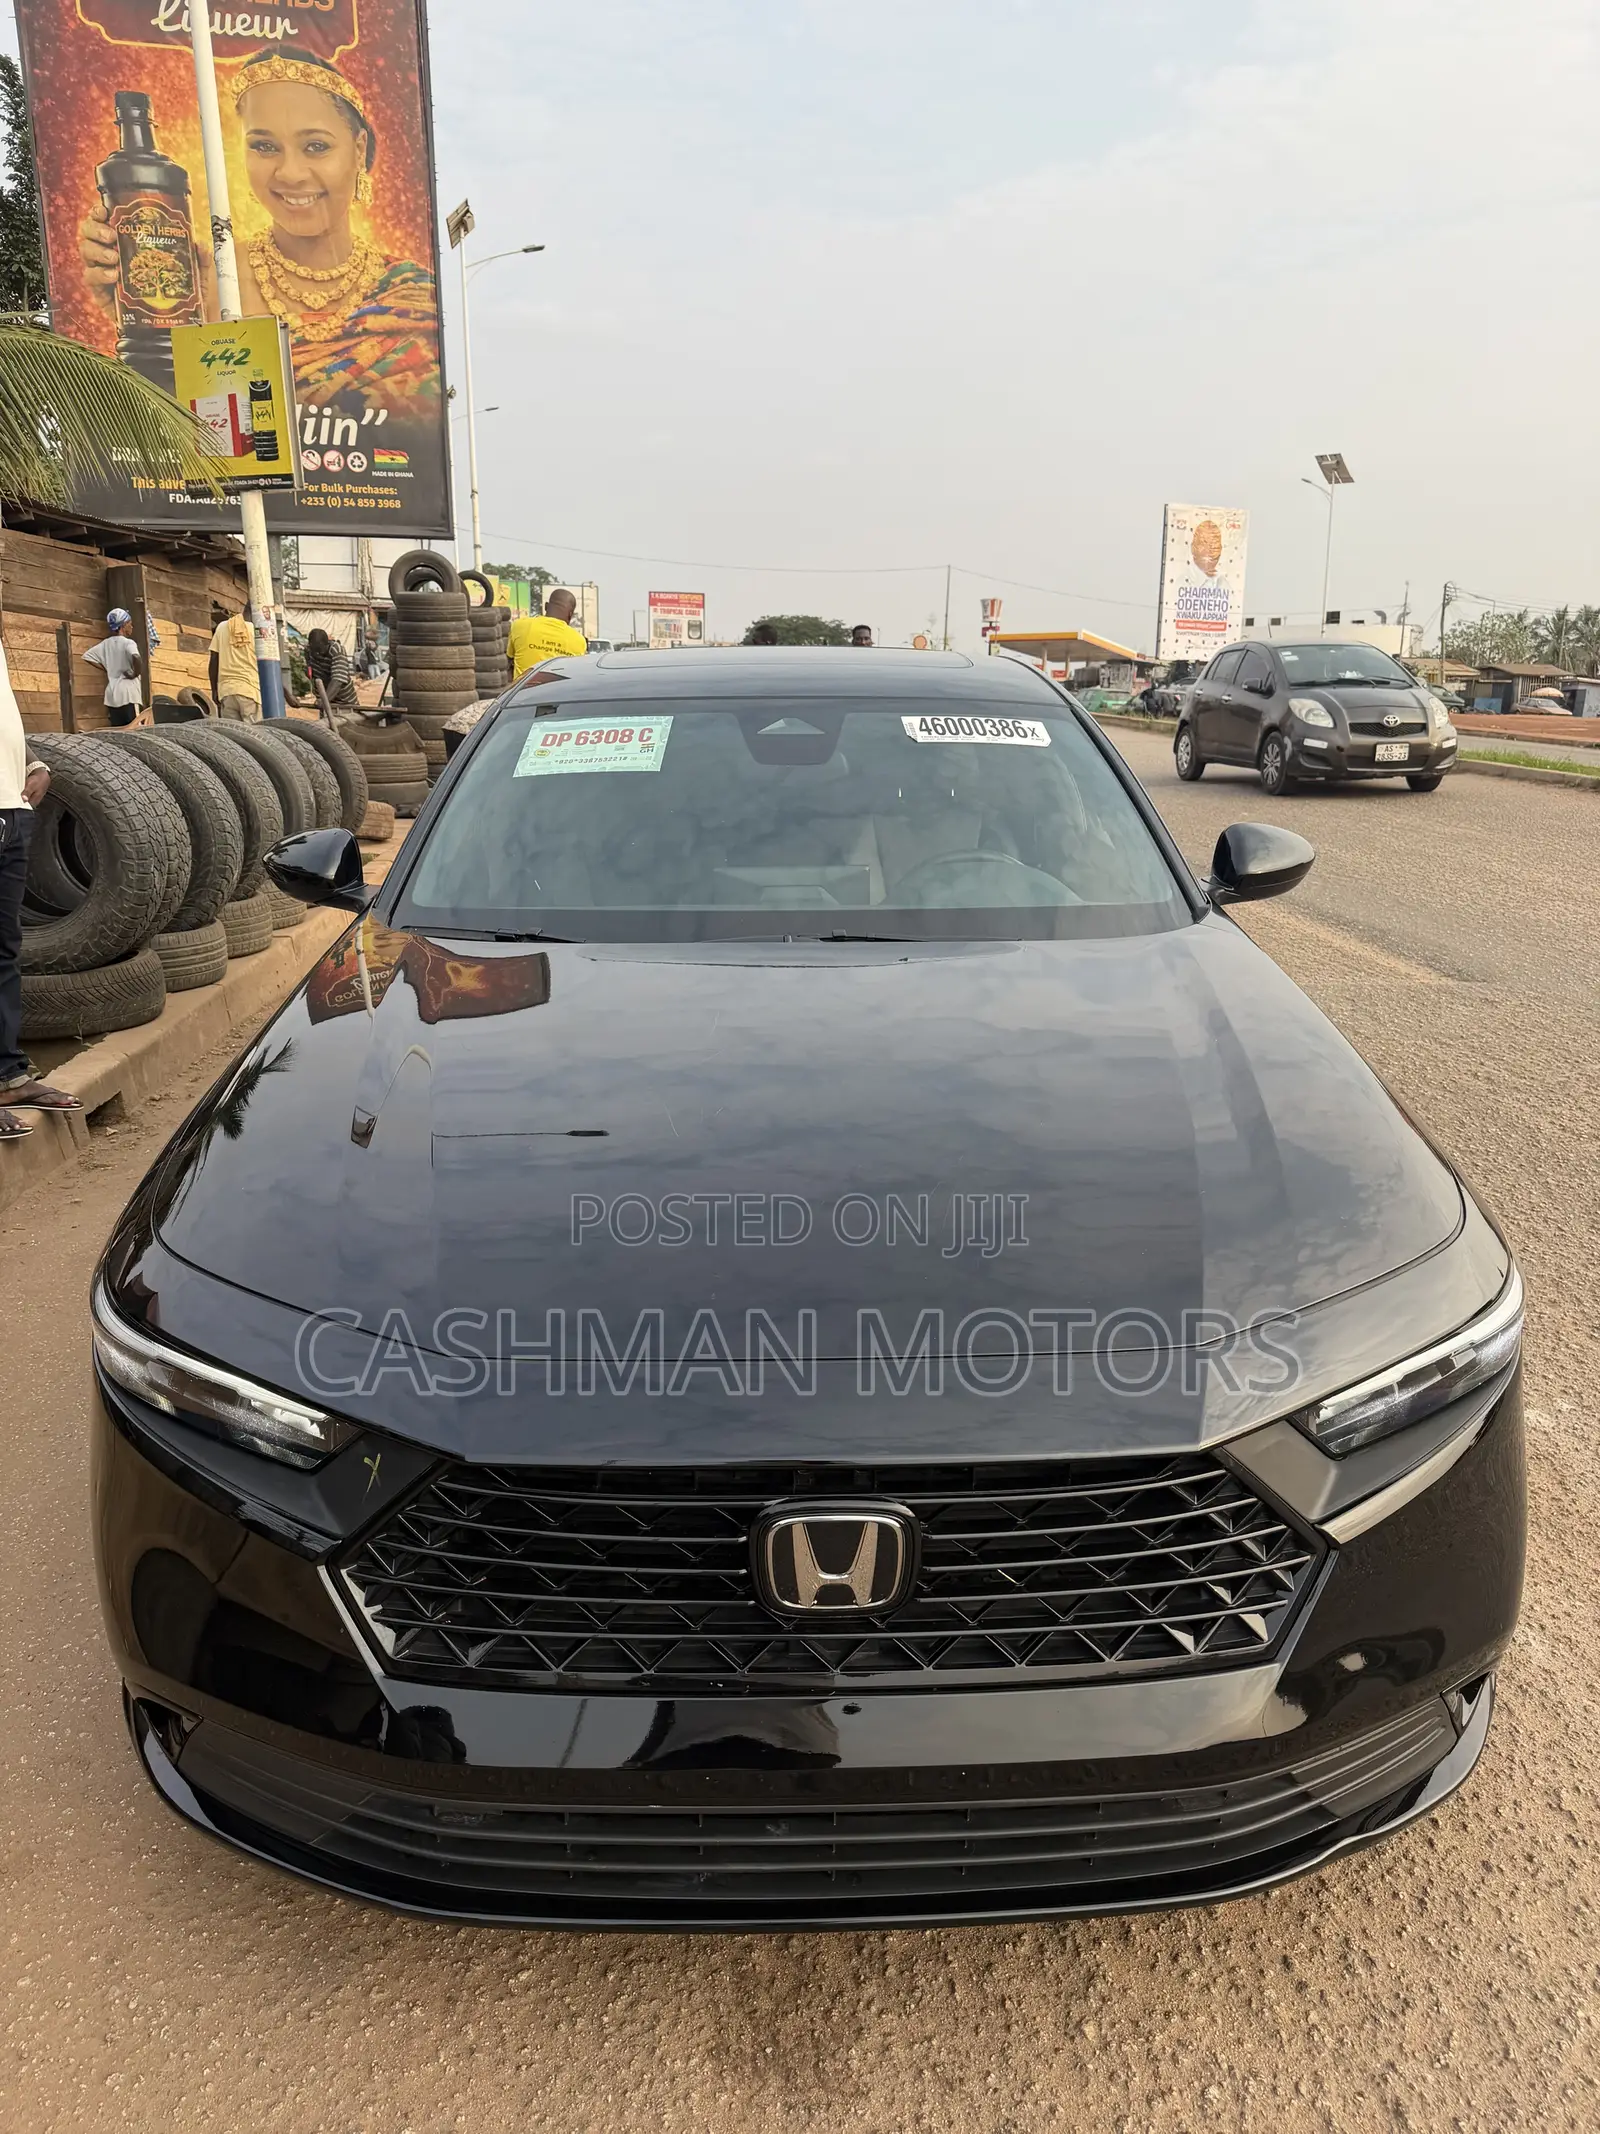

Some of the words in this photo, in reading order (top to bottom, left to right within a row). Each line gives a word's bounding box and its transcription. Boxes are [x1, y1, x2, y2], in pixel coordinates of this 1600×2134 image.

[118, 224, 156, 236] GOLDEN
[157, 226, 187, 238] HERBS
[135, 231, 177, 246] Liqueur
[211, 338, 236, 346] OBUASE
[199, 347, 251, 370] 442
[216, 369, 237, 377] LIQUOR
[131, 476, 156, 490] This
[303, 482, 319, 492] For
[321, 483, 344, 494] Bulk
[345, 483, 398, 495] Purchases:
[300, 496, 326, 506] +233
[327, 495, 342, 508] (0)
[343, 498, 356, 507] 54
[357, 498, 376, 508] 859
[377, 499, 401, 509] 3968
[1178, 587, 1230, 600] CHAIRMAN
[1177, 600, 1229, 613] ODENEHO
[1176, 612, 1201, 621] KWAKU
[1202, 613, 1228, 621] APPIAH
[528, 643, 553, 652] Change
[541, 732, 573, 747] DP
[574, 729, 635, 746] 6308
[638, 727, 654, 743] C
